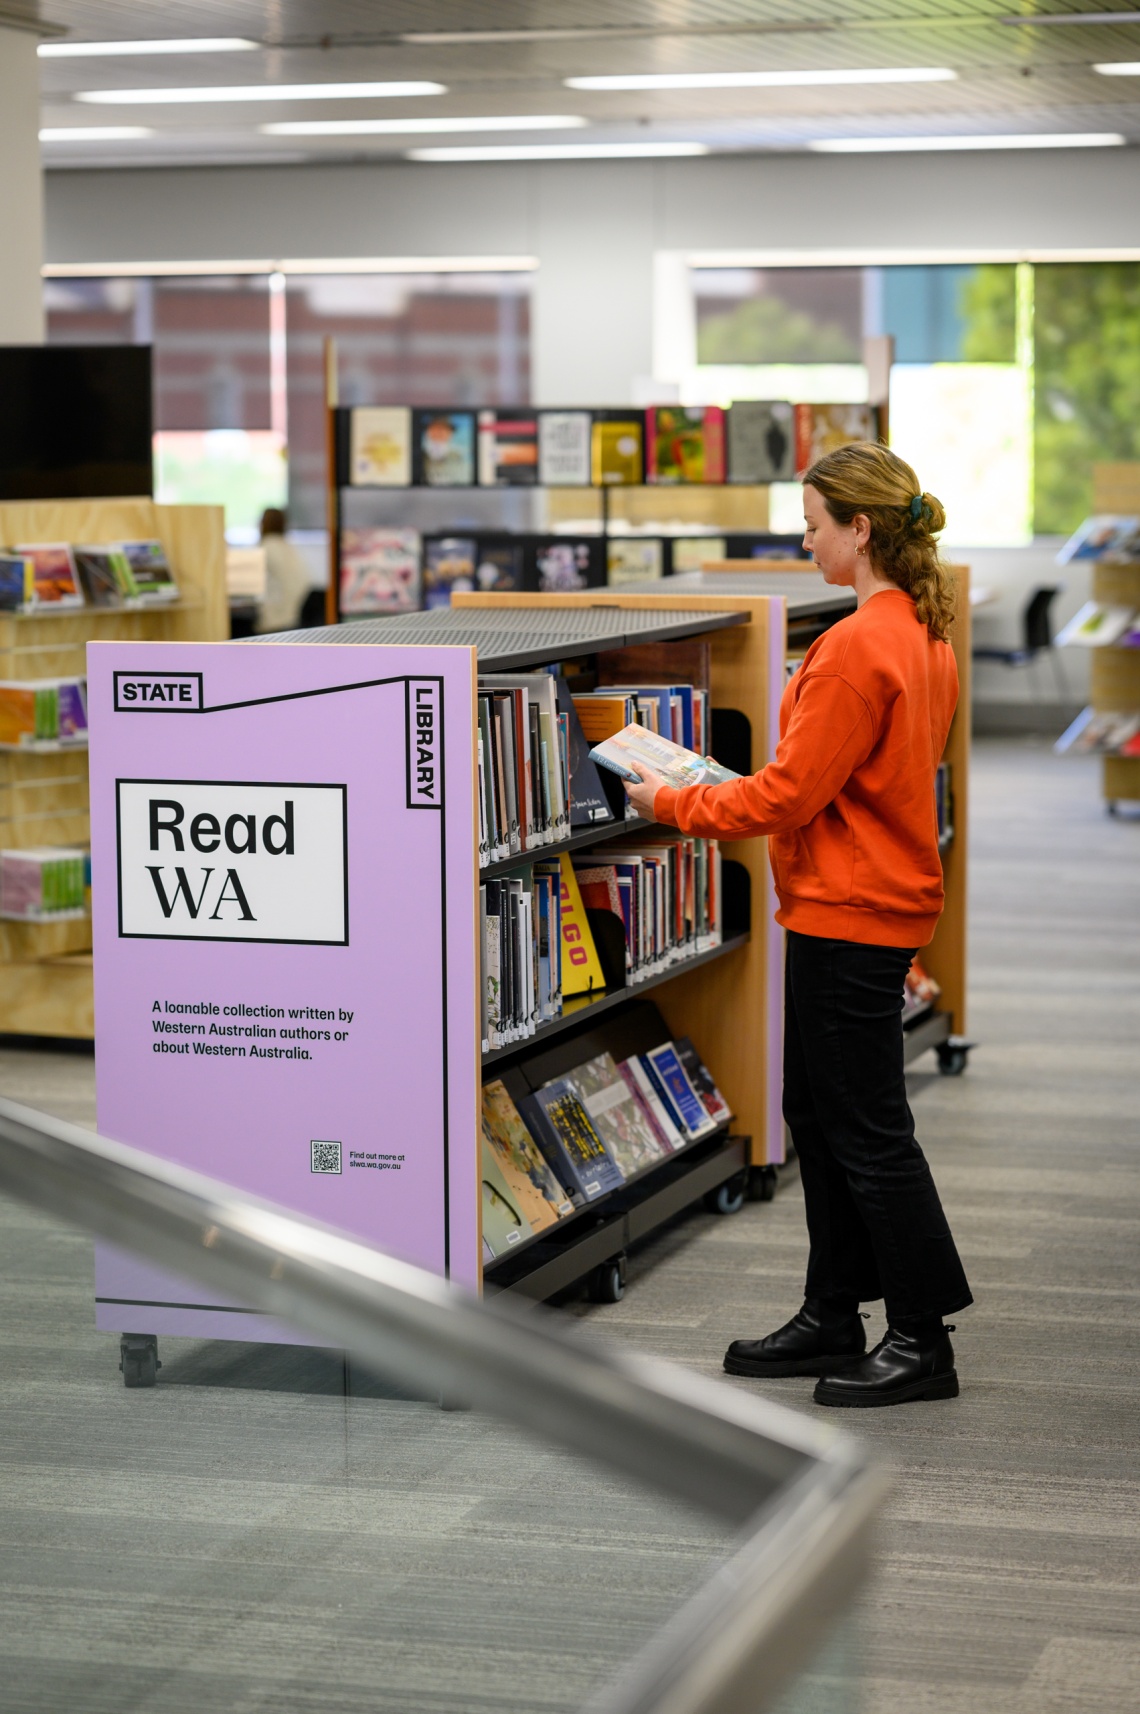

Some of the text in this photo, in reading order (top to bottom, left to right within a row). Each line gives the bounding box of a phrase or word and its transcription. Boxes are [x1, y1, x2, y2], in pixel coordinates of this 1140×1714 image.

[123, 683, 192, 701] STATE
[416, 688, 434, 799] LIBRARY
[149, 799, 295, 855] Read
[144, 865, 258, 921] WA
[152, 1000, 354, 1023] A loanable collection written by
[152, 1020, 349, 1041] Western Australian authors or
[152, 1040, 313, 1060] about Western Australia.
[350, 1151, 364, 1159] Find
[350, 1160, 401, 1170] slwa.wa.gov.au
